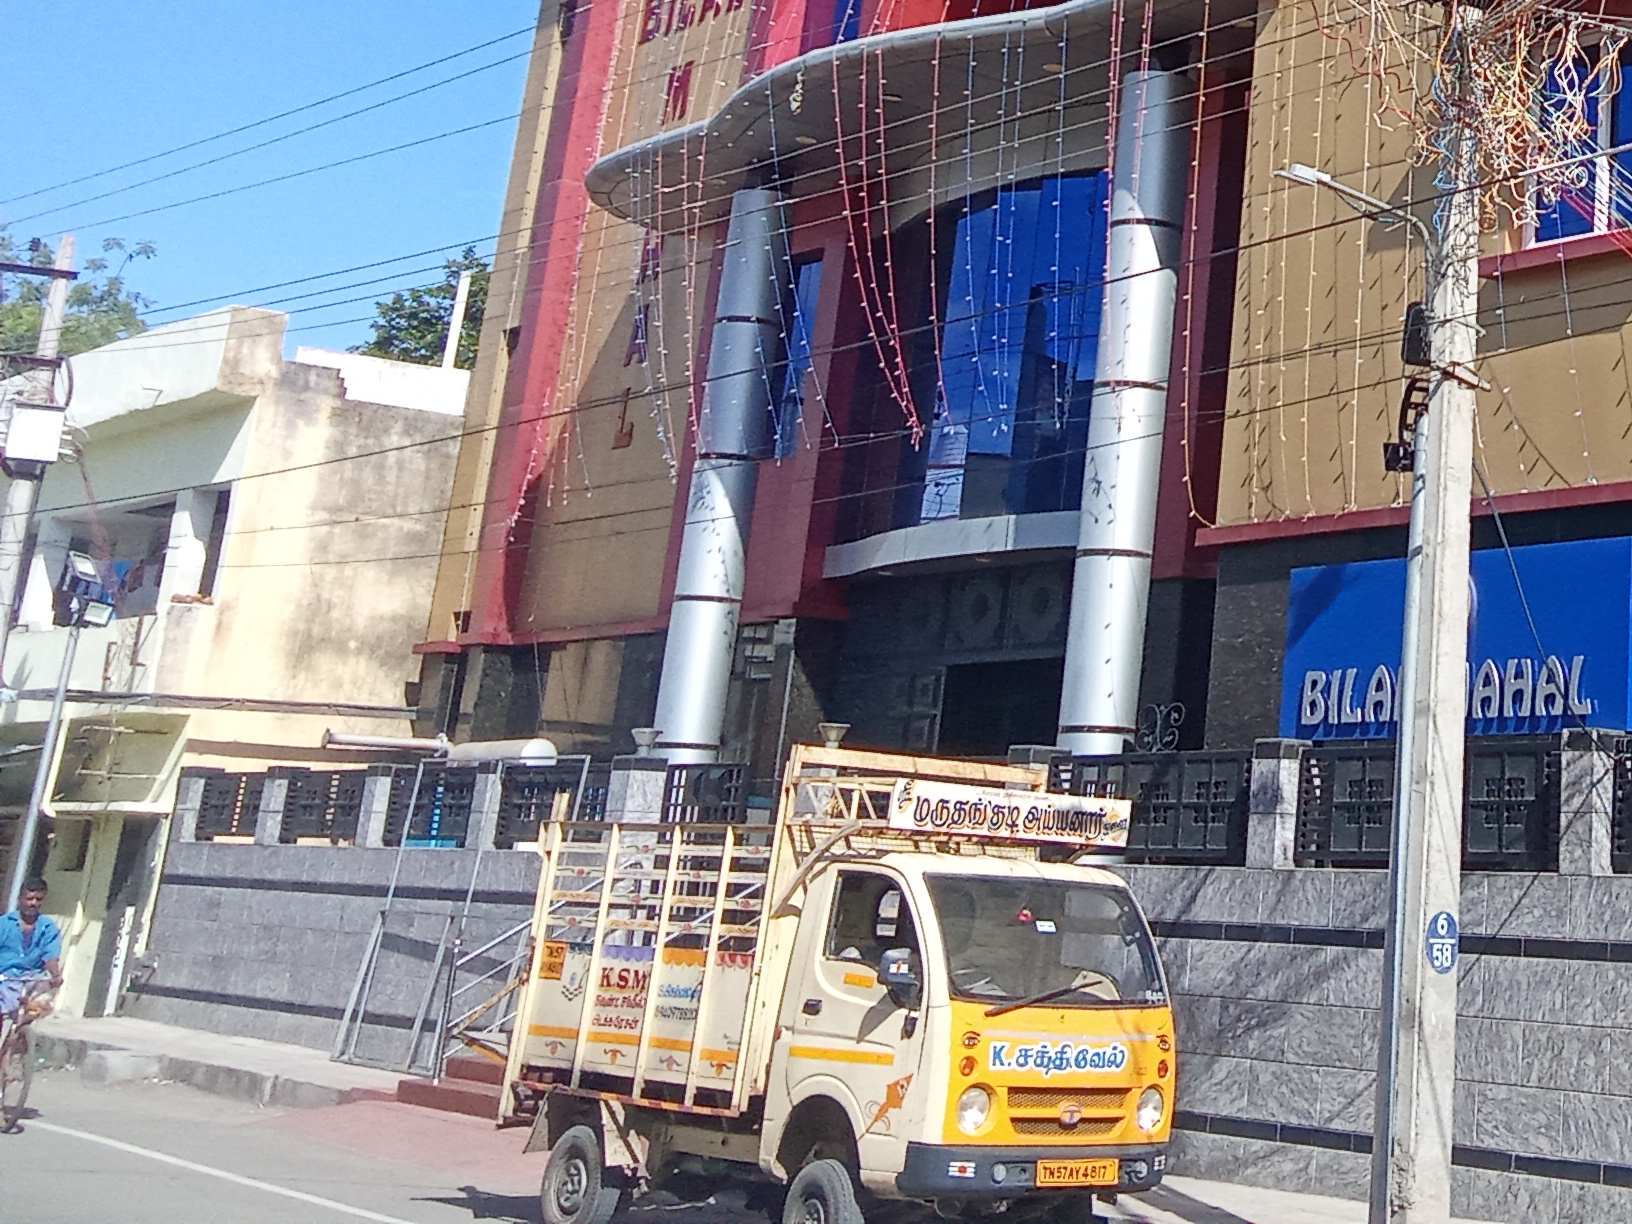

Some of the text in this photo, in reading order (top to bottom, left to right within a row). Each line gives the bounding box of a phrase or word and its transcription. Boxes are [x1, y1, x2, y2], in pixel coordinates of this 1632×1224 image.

[1300, 653, 1592, 726] BILA AHAL
[1437, 914, 1448, 935] 6
[1432, 943, 1452, 967] 58
